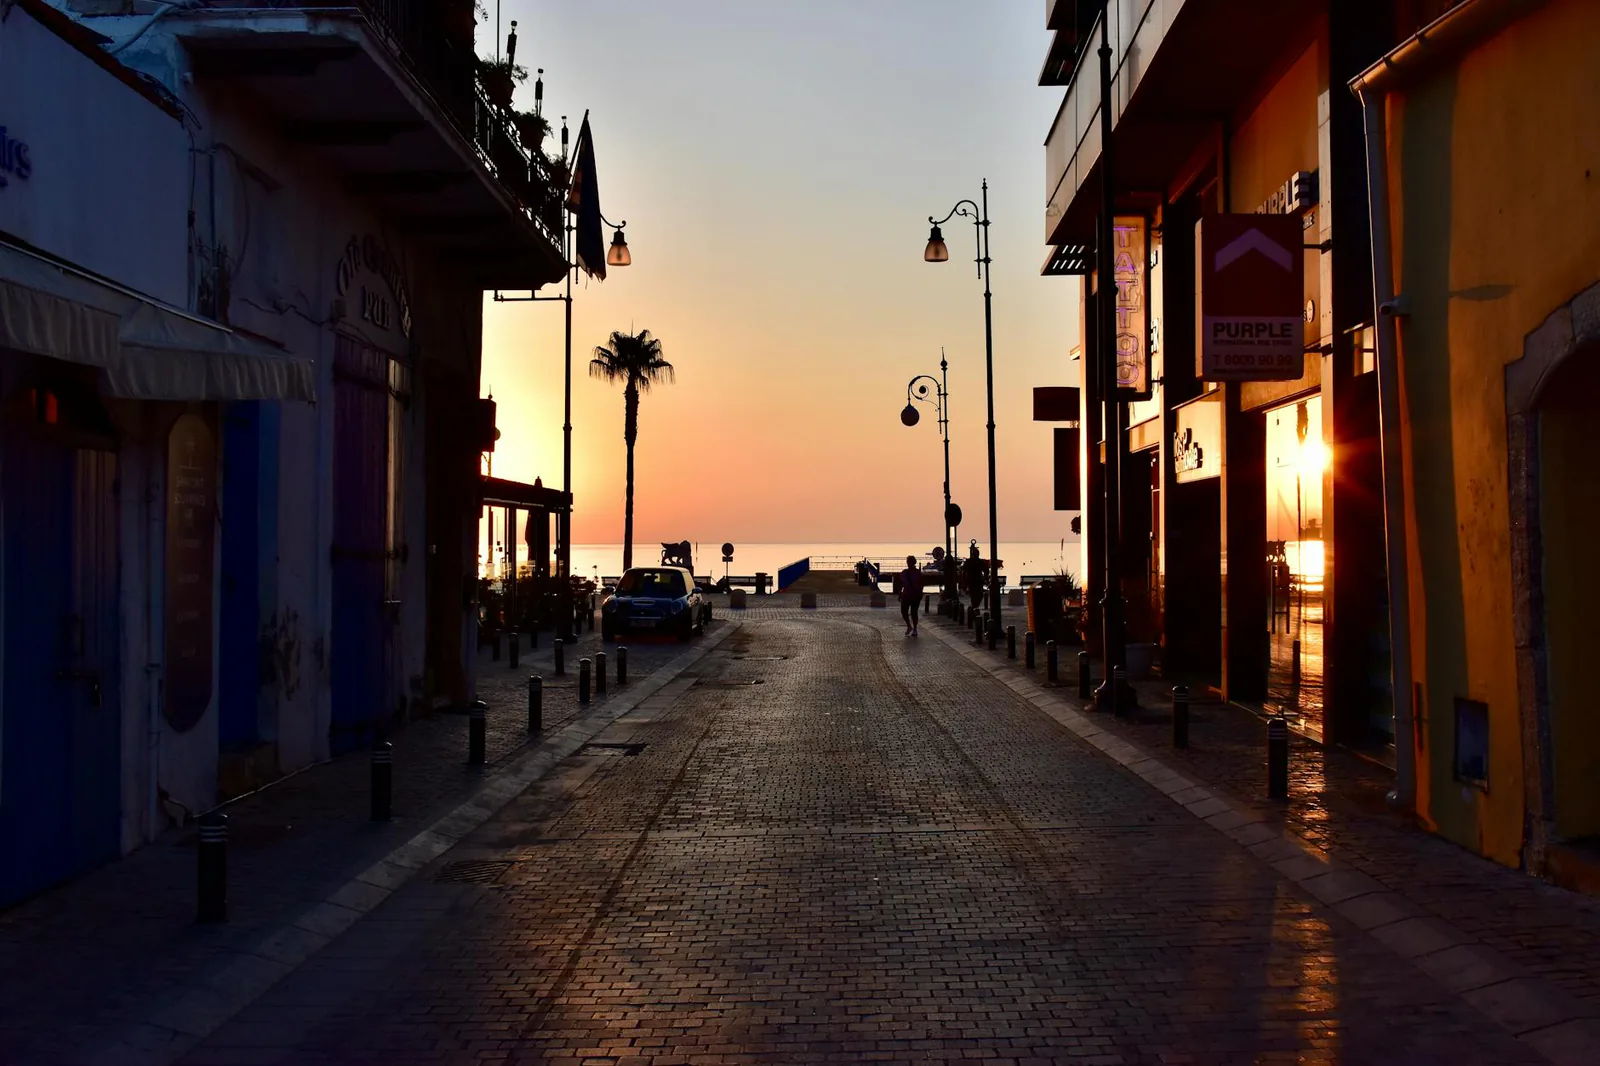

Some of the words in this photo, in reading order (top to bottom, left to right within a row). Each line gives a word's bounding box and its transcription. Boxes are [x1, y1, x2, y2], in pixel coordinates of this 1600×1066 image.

[361, 283, 391, 331] PUB
[1113, 226, 1139, 385] TATTOO
[1213, 322, 1293, 338] PURPLE
[1212, 354, 1220, 365] T
[1224, 354, 1255, 366] 8000
[1258, 354, 1274, 366] 90
